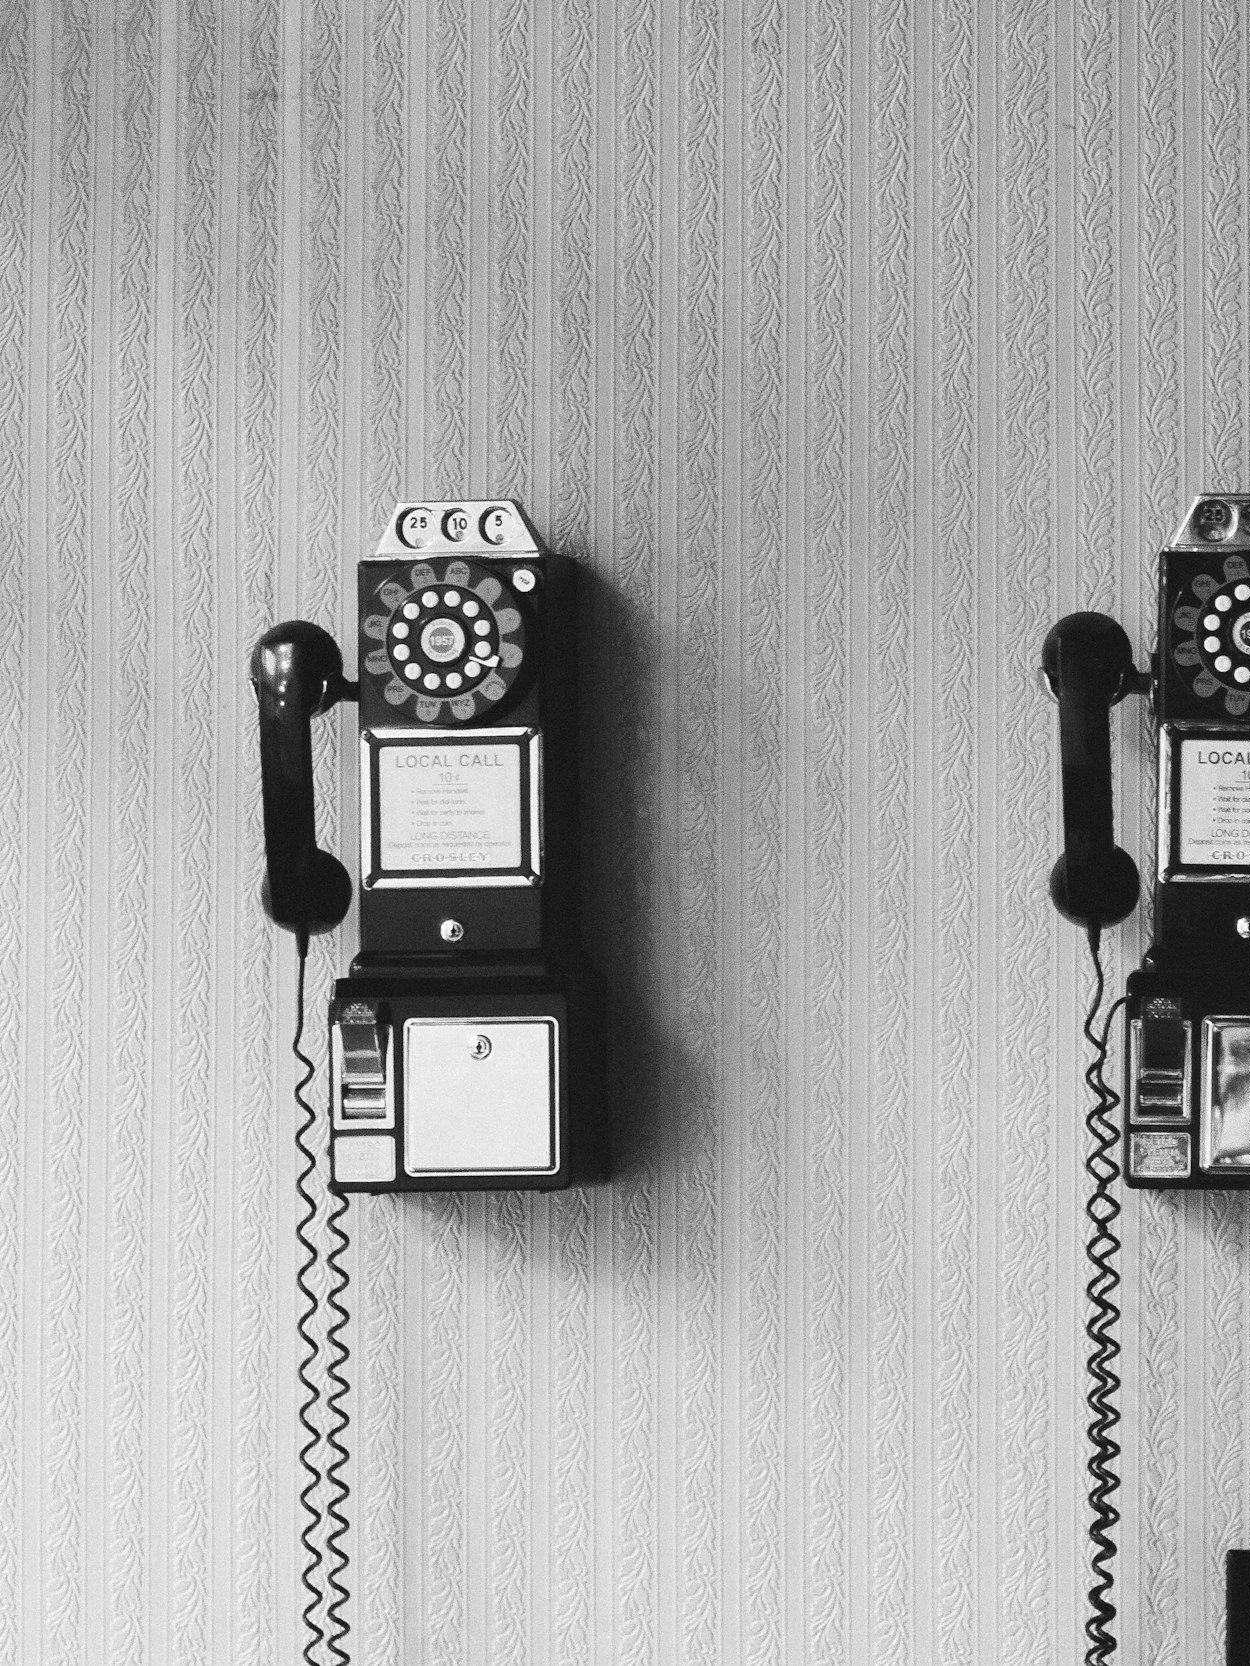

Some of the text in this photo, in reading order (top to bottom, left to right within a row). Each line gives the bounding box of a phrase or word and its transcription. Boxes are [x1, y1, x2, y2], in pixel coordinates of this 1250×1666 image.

[1204, 507, 1224, 522] 25
[410, 517, 428, 529] 25
[452, 518, 467, 530] 10
[495, 515, 503, 527] 5
[430, 636, 454, 646] 1957
[395, 754, 503, 769] LOCAL CALL
[411, 831, 489, 840] LONG DISTANCE
[1211, 829, 1239, 837] LONG
[411, 852, 489, 862] CROSLEY
